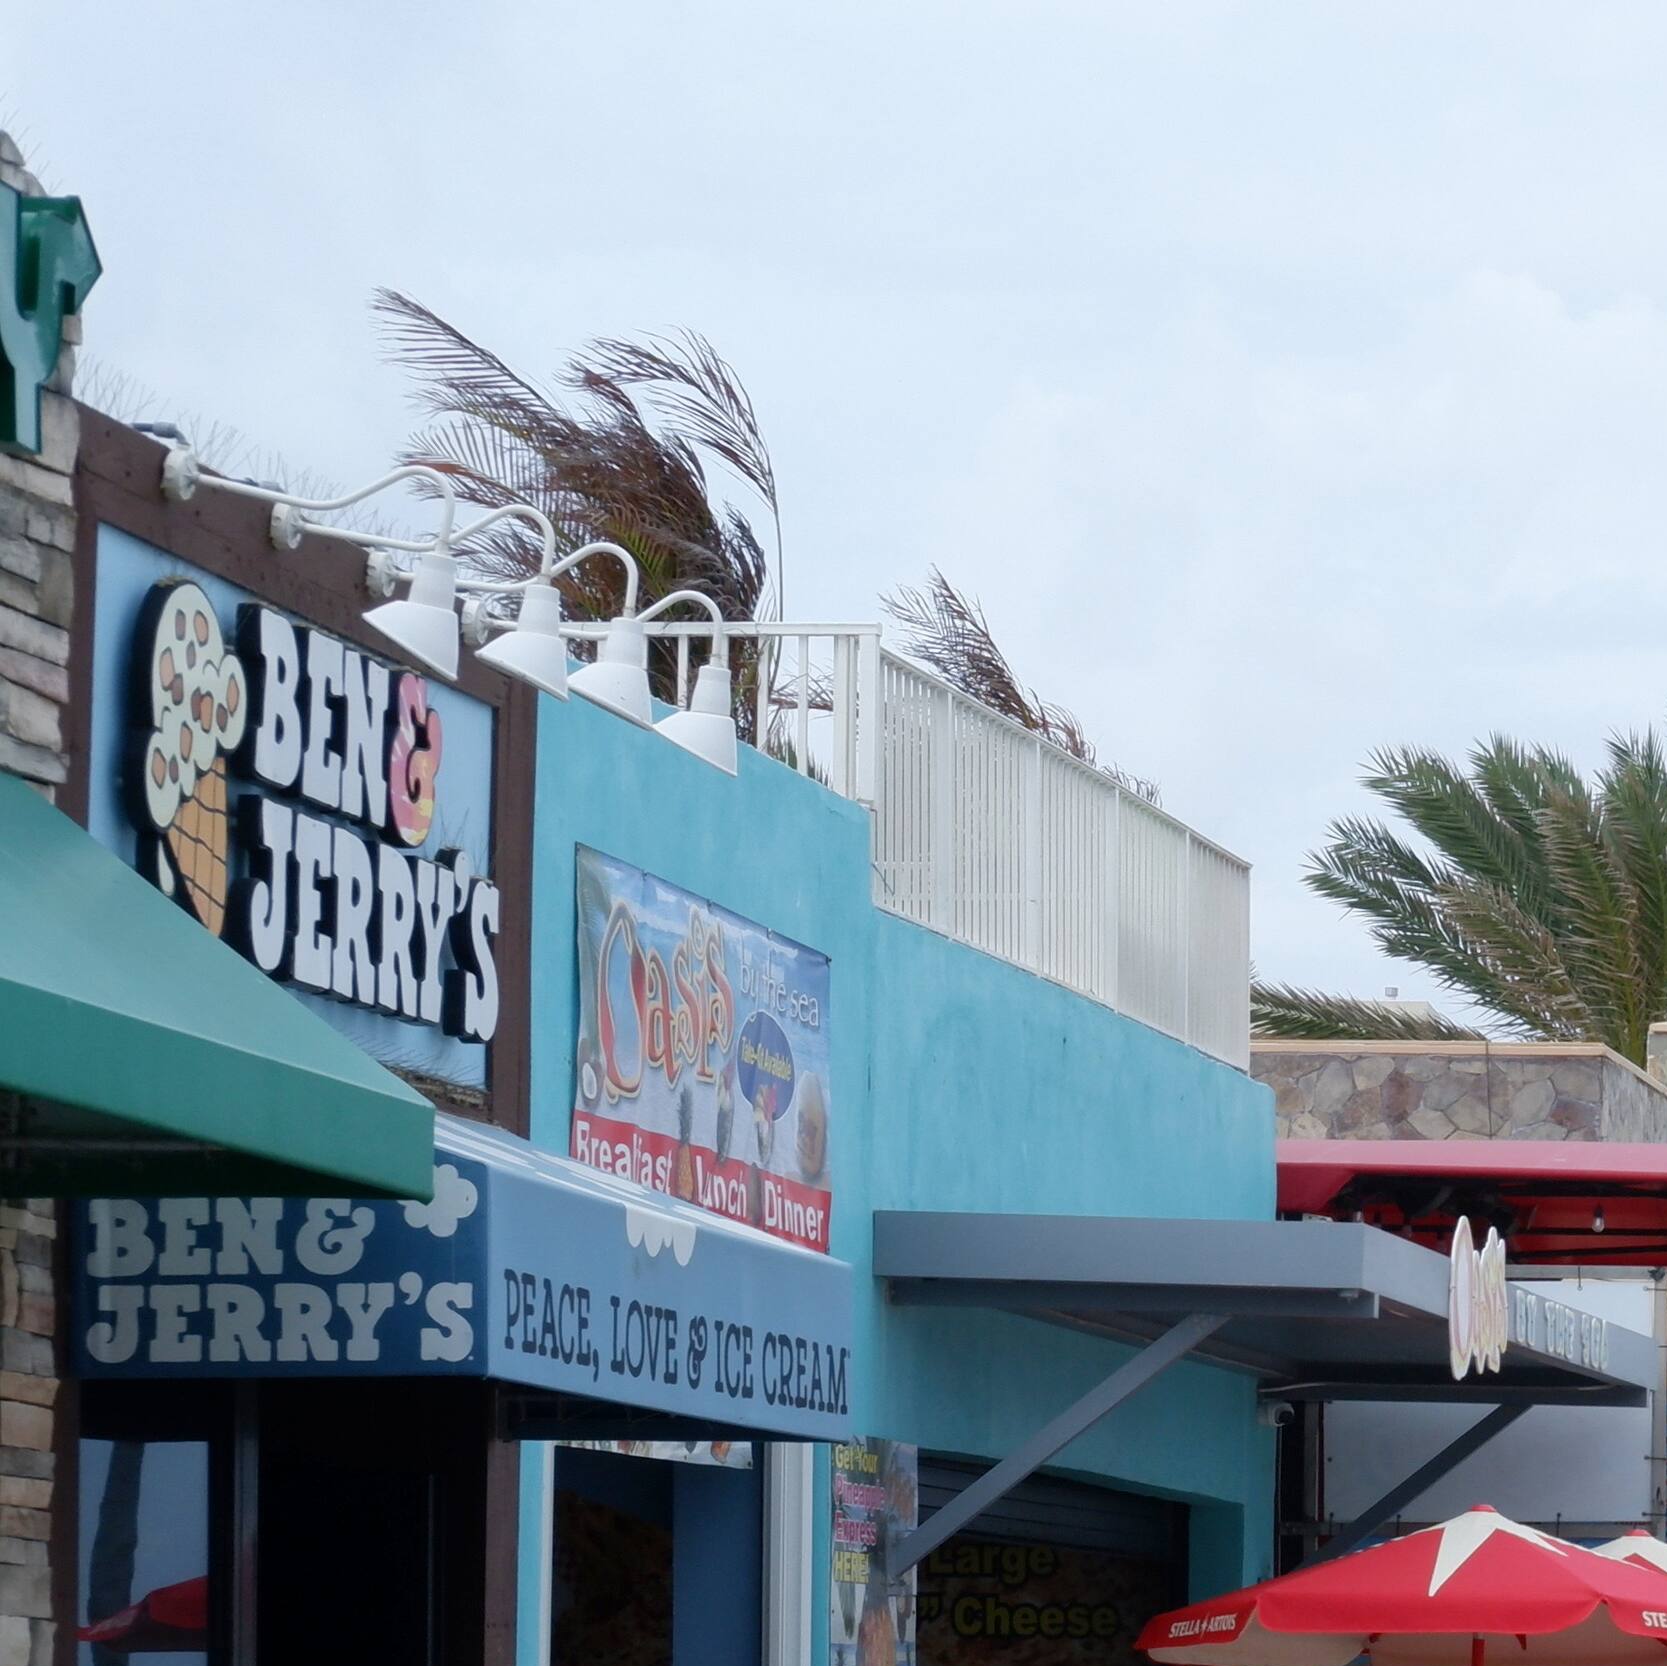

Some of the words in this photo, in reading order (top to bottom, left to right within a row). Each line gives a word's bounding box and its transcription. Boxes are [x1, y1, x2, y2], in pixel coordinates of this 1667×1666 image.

[253, 607, 390, 829] BEN
[389, 672, 443, 849] &
[250, 798, 500, 1042] JERRY'S
[600, 901, 736, 1104] Oasis
[790, 990, 819, 1027] sea
[87, 1197, 284, 1278] BEN
[295, 1197, 376, 1276] &
[764, 1180, 824, 1243] Dinner
[86, 1270, 474, 1363] JERRY'S
[504, 1268, 600, 1383] PEACE,
[610, 1295, 678, 1385] LOVE
[687, 1315, 708, 1389] &
[714, 1320, 754, 1399] ICE
[761, 1331, 848, 1415] CREAM
[834, 1443, 853, 1470] Get
[855, 1444, 879, 1473] Your
[834, 1510, 878, 1546] Express
[927, 1541, 1056, 1587] Large
[953, 1596, 1120, 1637] Cheese
[1168, 1619, 1200, 1638] STELLA
[1207, 1614, 1237, 1632] ARTOIS
